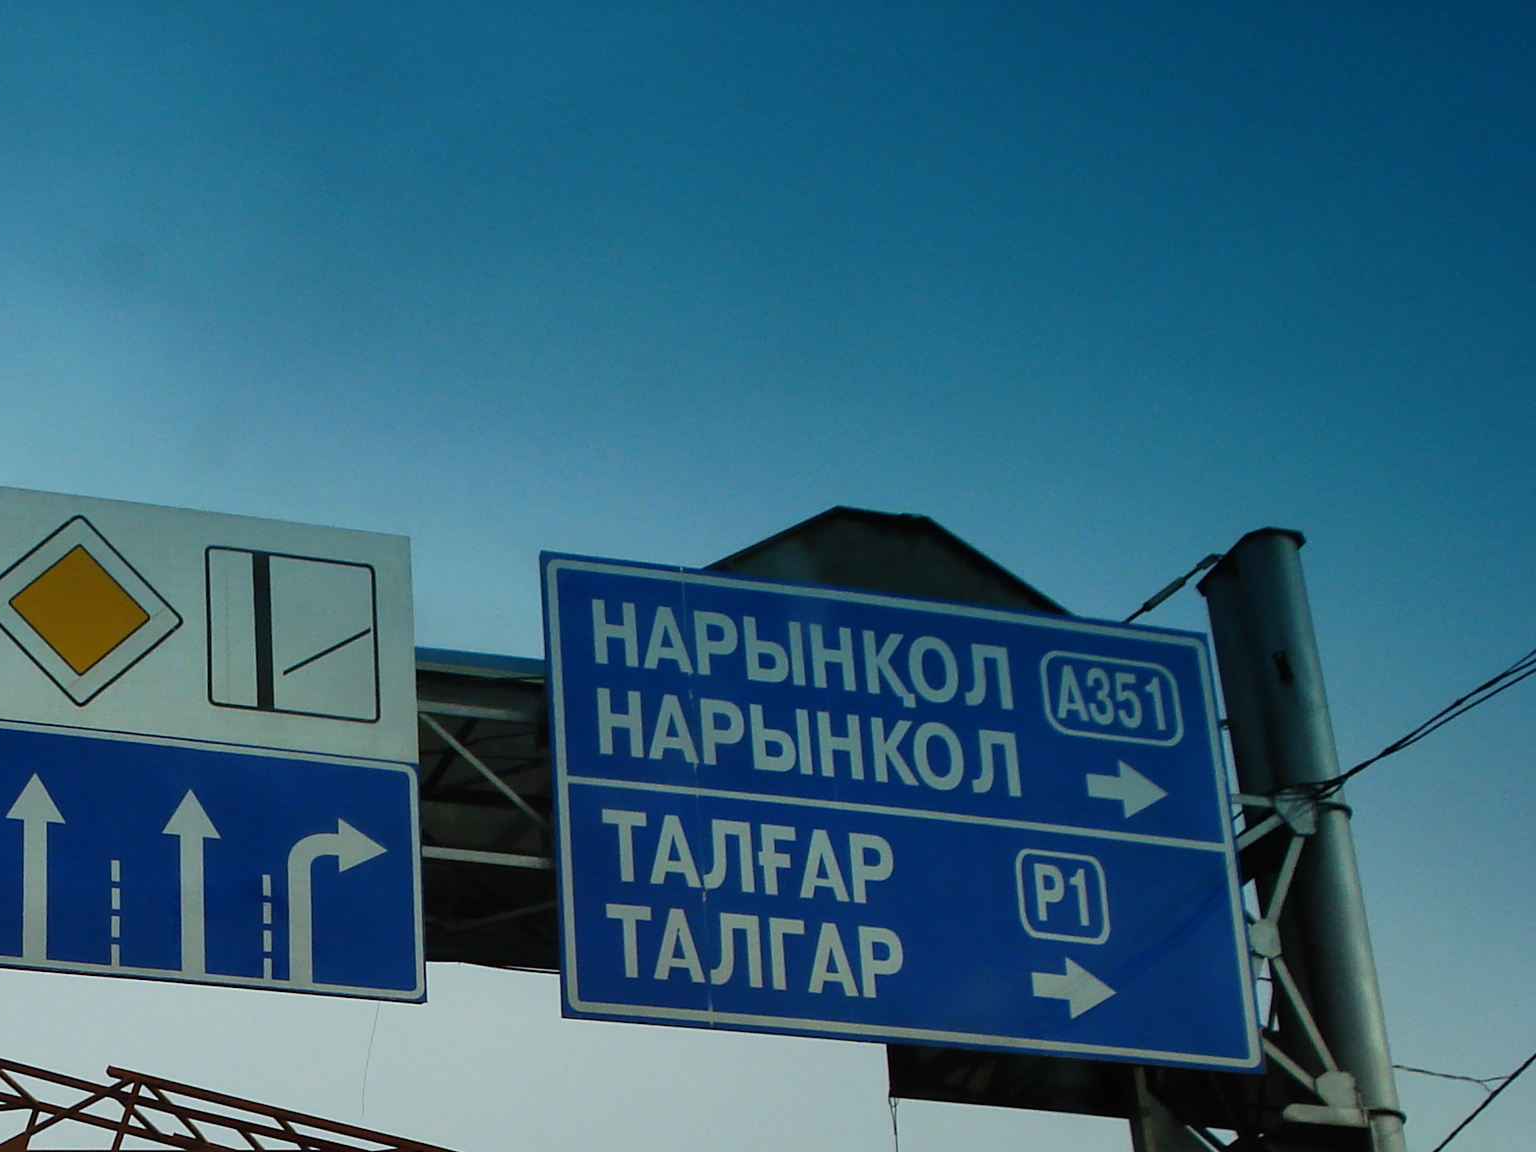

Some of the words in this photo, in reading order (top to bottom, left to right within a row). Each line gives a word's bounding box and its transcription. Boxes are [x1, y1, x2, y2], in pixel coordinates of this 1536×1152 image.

[591, 599, 1015, 710] НАРЫНҚОЛ
[596, 688, 1022, 797] НАРЫНКОЛ
[601, 808, 895, 904] ТАЛҒАР
[605, 904, 905, 999] ТАЛГАР
